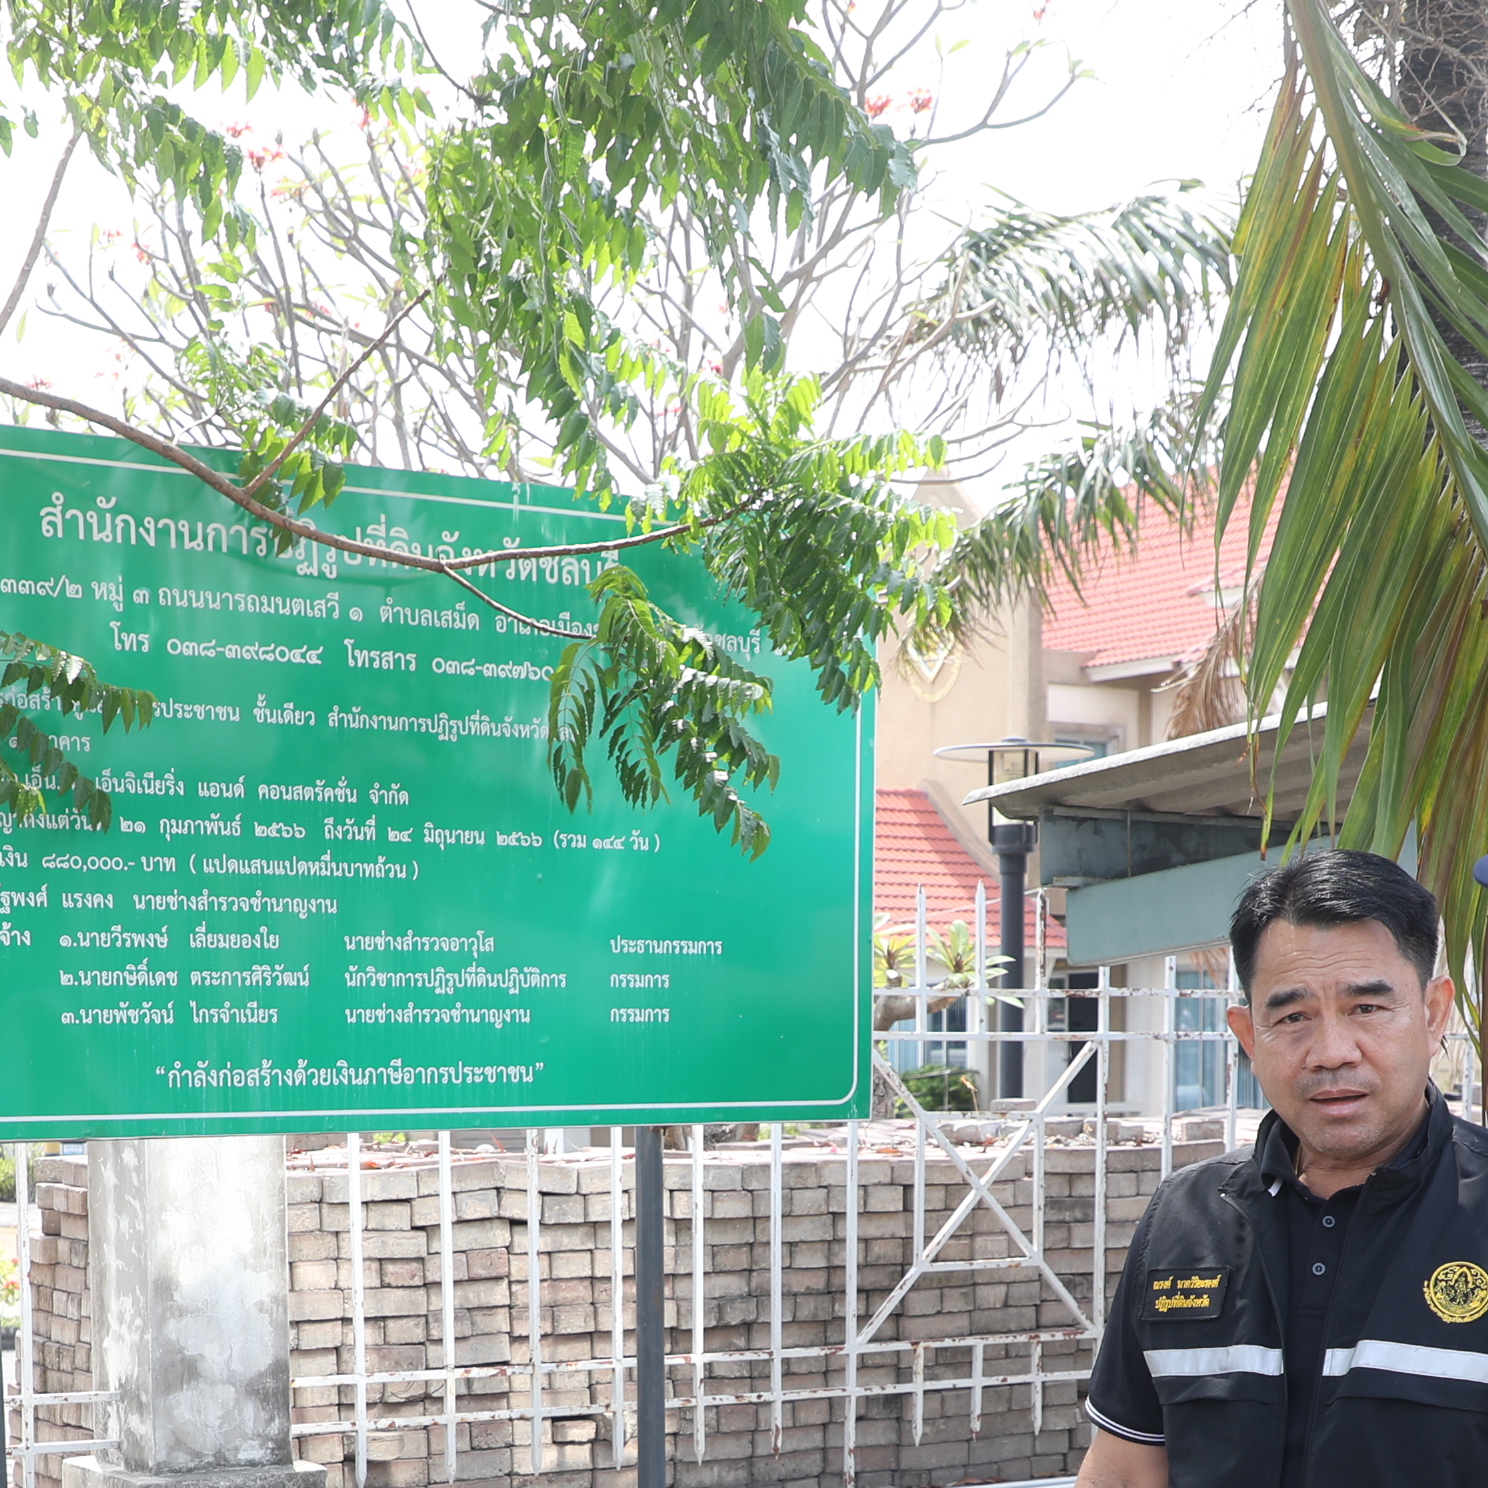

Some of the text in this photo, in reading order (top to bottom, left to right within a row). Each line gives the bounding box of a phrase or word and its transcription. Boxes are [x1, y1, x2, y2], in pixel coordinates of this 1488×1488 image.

[0, 574, 83, 600] ๓๓๙/๒
[91, 576, 124, 612] หมู่
[132, 586, 150, 605] ๓
[379, 597, 480, 631] ตำบลเสม็ด
[109, 621, 150, 652] โทร
[343, 638, 417, 672] โทรสาร
[252, 693, 316, 726] ชั้นเดียว
[198, 774, 245, 799] แอนด์
[257, 775, 358, 803] คอนสตรัคชั่น
[368, 781, 410, 806] จำกัด
[119, 816, 147, 834] ๒๑
[159, 812, 242, 842] กุมภาพันธ์
[254, 821, 306, 838] ๒๕๖๖
[323, 814, 377, 842] ถึงวันที่
[386, 826, 414, 843] ๒๔
[423, 822, 486, 851] มิถุนายน
[496, 830, 543, 847] ๒๕๖๖
[141, 856, 176, 872] บาท
[62, 892, 114, 909] แรงคง
[133, 888, 338, 919] นายช่างสำรวจชำนาญงาน
[59, 924, 169, 949] ๑.นายวีรพงษ์
[189, 921, 280, 949] เลี่ยมยองใย
[344, 929, 495, 959] นายช่างสำรวจอาวุโส
[610, 935, 723, 955] ประธานกรรมการ
[190, 963, 310, 988] ตระการศิริวัฒน์
[344, 961, 567, 995] นักวิชาการปฏิรูปที่ดินปฏิบัติการ
[609, 973, 670, 988] กรรมการ
[60, 999, 670, 1029] ๓.นายพัชวัจน์ ไกรจำเนียร นายช่างสำรวจชำนาญงาน กรรมการ
